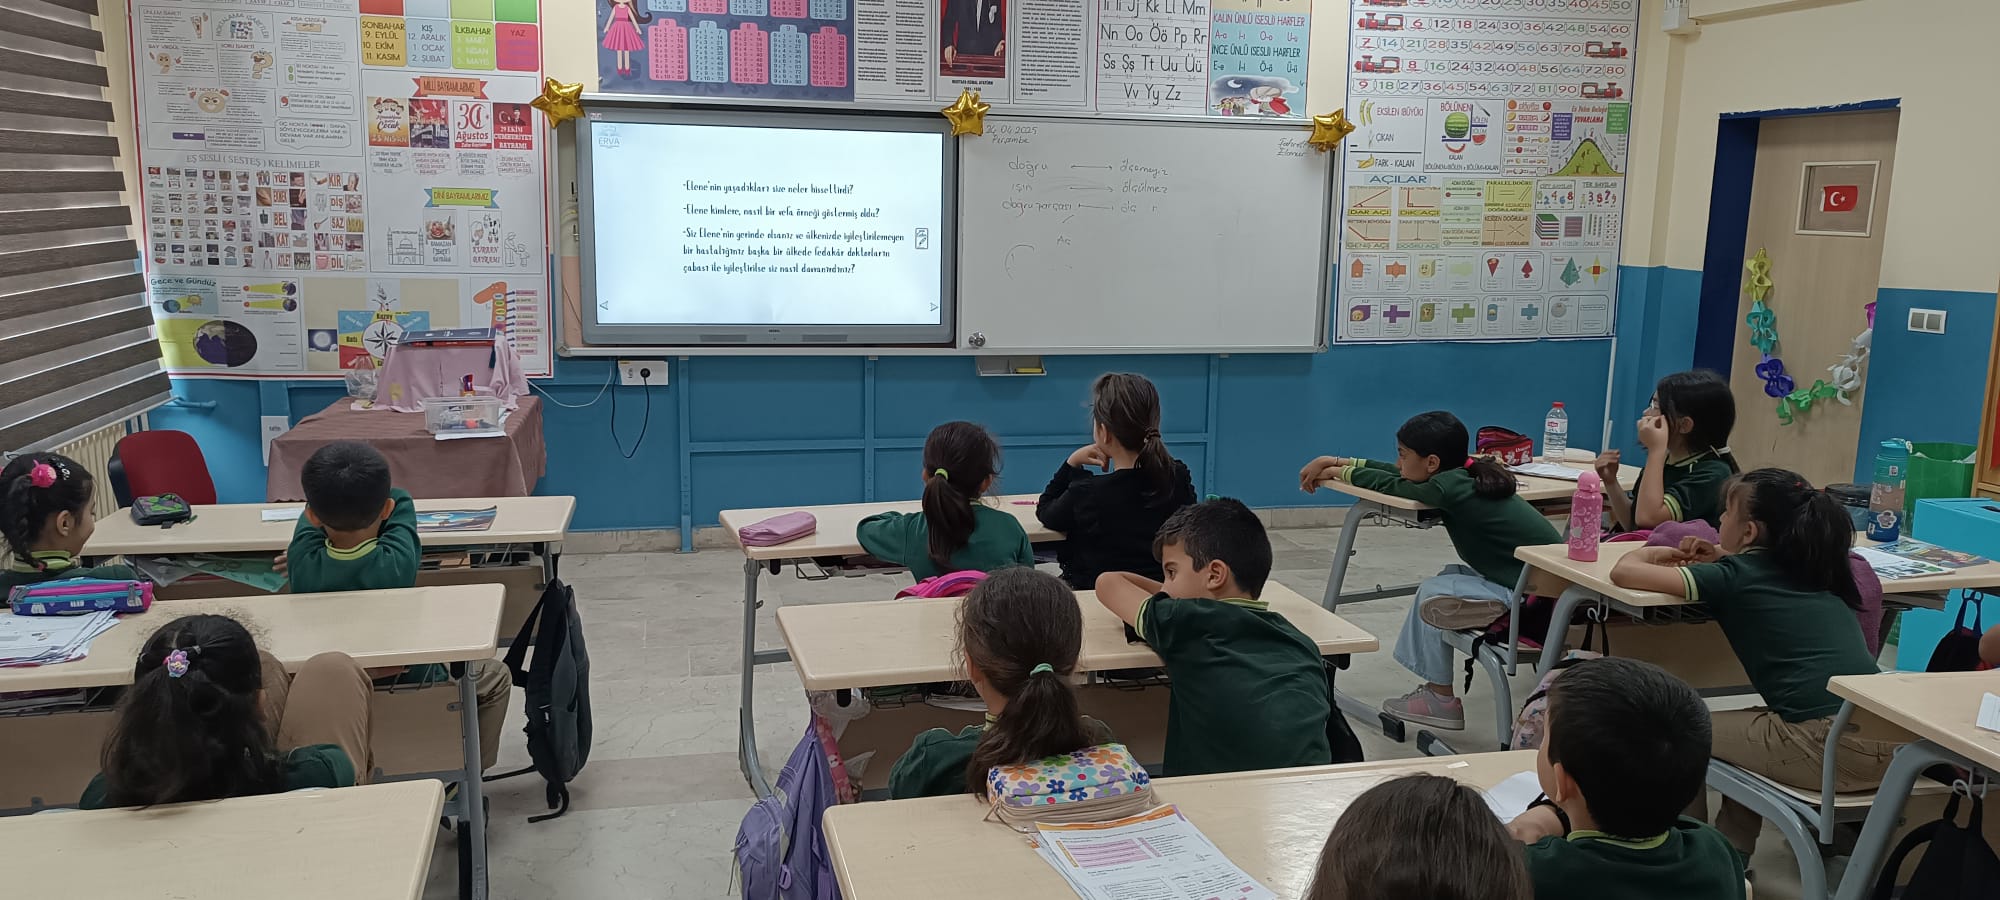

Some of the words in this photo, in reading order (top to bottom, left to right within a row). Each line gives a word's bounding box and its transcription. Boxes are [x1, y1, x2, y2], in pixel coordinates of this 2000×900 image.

[1182, 0, 1206, 16] Mm
[362, 21, 405, 31] SONBAHAR
[1214, 15, 1233, 24] KALIN
[1235, 15, 1253, 24] ÜNLÜ
[1278, 17, 1305, 27] HARFLER
[1413, 19, 1423, 28] 6
[1435, 20, 1449, 28] 12
[1458, 21, 1472, 29] 18
[1479, 22, 1496, 30] 24
[1502, 22, 1520, 30] 30
[1525, 23, 1542, 31] 36
[1546, 24, 1564, 32] 42
[1568, 24, 1585, 32] 48
[1590, 25, 1607, 33] 54
[375, 31, 399, 40] EYLÜL
[422, 25, 433, 34] KIŞ
[455, 25, 492, 35] İLKBAHAR
[511, 29, 526, 37] YAZ
[421, 34, 447, 42] ARALIK
[1101, 23, 1119, 40] Nn
[1126, 25, 1143, 41] Oo
[1150, 23, 1168, 43] Öö
[1174, 27, 1187, 49] Pp
[1194, 28, 1207, 44] Rr
[376, 42, 394, 50] EKİM
[422, 44, 445, 52] OCAK
[1212, 44, 1229, 55] İNCE
[1231, 45, 1249, 56] ÜNLÜ
[1273, 48, 1301, 58] HARFLER
[377, 53, 401, 61] KASIM
[422, 55, 445, 63] ŞUBAT
[1104, 53, 1116, 70] Ss
[1122, 54, 1135, 73] Şş
[1141, 55, 1154, 71] Tt
[1161, 56, 1178, 72] Uu
[1185, 53, 1202, 73] Üü
[1408, 61, 1417, 69] 8
[1431, 62, 1445, 70] 16
[1451, 63, 1471, 71] 24
[1475, 63, 1493, 71] 32
[1497, 64, 1516, 72] 40
[1541, 65, 1559, 73] 56
[1585, 66, 1602, 74] 72
[1607, 67, 1625, 75] 80
[437, 81, 476, 93] BAYRAMLARIMIZ
[1360, 81, 1369, 89] 9
[1380, 81, 1394, 89] 18
[1401, 82, 1419, 90] 27
[1424, 83, 1442, 91] 36
[1447, 83, 1465, 91] 45
[1469, 83, 1487, 91] 54
[1492, 84, 1509, 92] 63
[1514, 85, 1531, 93] 72
[1539, 85, 1552, 93] 81
[1124, 83, 1139, 99] Vv
[1145, 84, 1160, 106] Yy
[1166, 85, 1181, 101] Zz
[1377, 106, 1400, 117] EKSİLEN
[1441, 102, 1472, 112] BÖLÜNEN
[457, 131, 489, 142] Ağustos
[599, 137, 620, 145] ERVA
[1376, 133, 1395, 143] ÇIKAN
[186, 155, 197, 163] EŞ
[199, 154, 221, 162] SESLİ
[228, 156, 261, 166] SESTEŞ
[269, 160, 321, 169] KELİMELER
[1009, 155, 1048, 178] doğru
[1375, 159, 1389, 168] FARK
[1395, 159, 1415, 169] KALAN
[274, 174, 287, 183] YÜZ
[329, 173, 341, 187] KIR
[1369, 175, 1428, 185] AÇILAR
[724, 182, 770, 194] yaşadıkları
[773, 185, 786, 193] size
[788, 183, 808, 194] neler
[811, 184, 854, 194] hissettirdi?
[1122, 180, 1168, 194] ölçülmez
[331, 196, 343, 209] DİŞ
[446, 192, 489, 201] BAYRAMLARIMIZ
[711, 204, 741, 216] kimlere,
[744, 206, 763, 216] nasıl
[766, 205, 775, 216] bir
[797, 208, 820, 220] örneği
[822, 207, 858, 220] göstermiş
[861, 208, 880, 218] oldu?
[1002, 197, 1033, 218] doğru
[273, 213, 288, 226] BEL
[331, 217, 344, 229] SAZ
[276, 233, 289, 247] KAT
[700, 227, 735, 239] Elene'nin
[737, 229, 765, 241] yerinde
[768, 229, 794, 240] olsanız
[806, 230, 842, 240] ülkenizde
[844, 231, 905, 243] iyileştirilemeyen
[332, 235, 344, 249] YAŞ
[684, 244, 693, 255] bir
[696, 245, 745, 258] hastalığınız
[748, 245, 770, 257] başka
[773, 246, 783, 256] bir
[786, 246, 812, 257] ülkede
[848, 247, 890, 257] doktorların
[331, 255, 344, 269] DİL
[683, 261, 709, 273] çabası
[712, 262, 722, 272] ile
[724, 262, 766, 274] iyileştirilse
[769, 265, 778, 273] siz
[780, 263, 799, 273] nasıl
[186, 277, 217, 287] Gündüz
